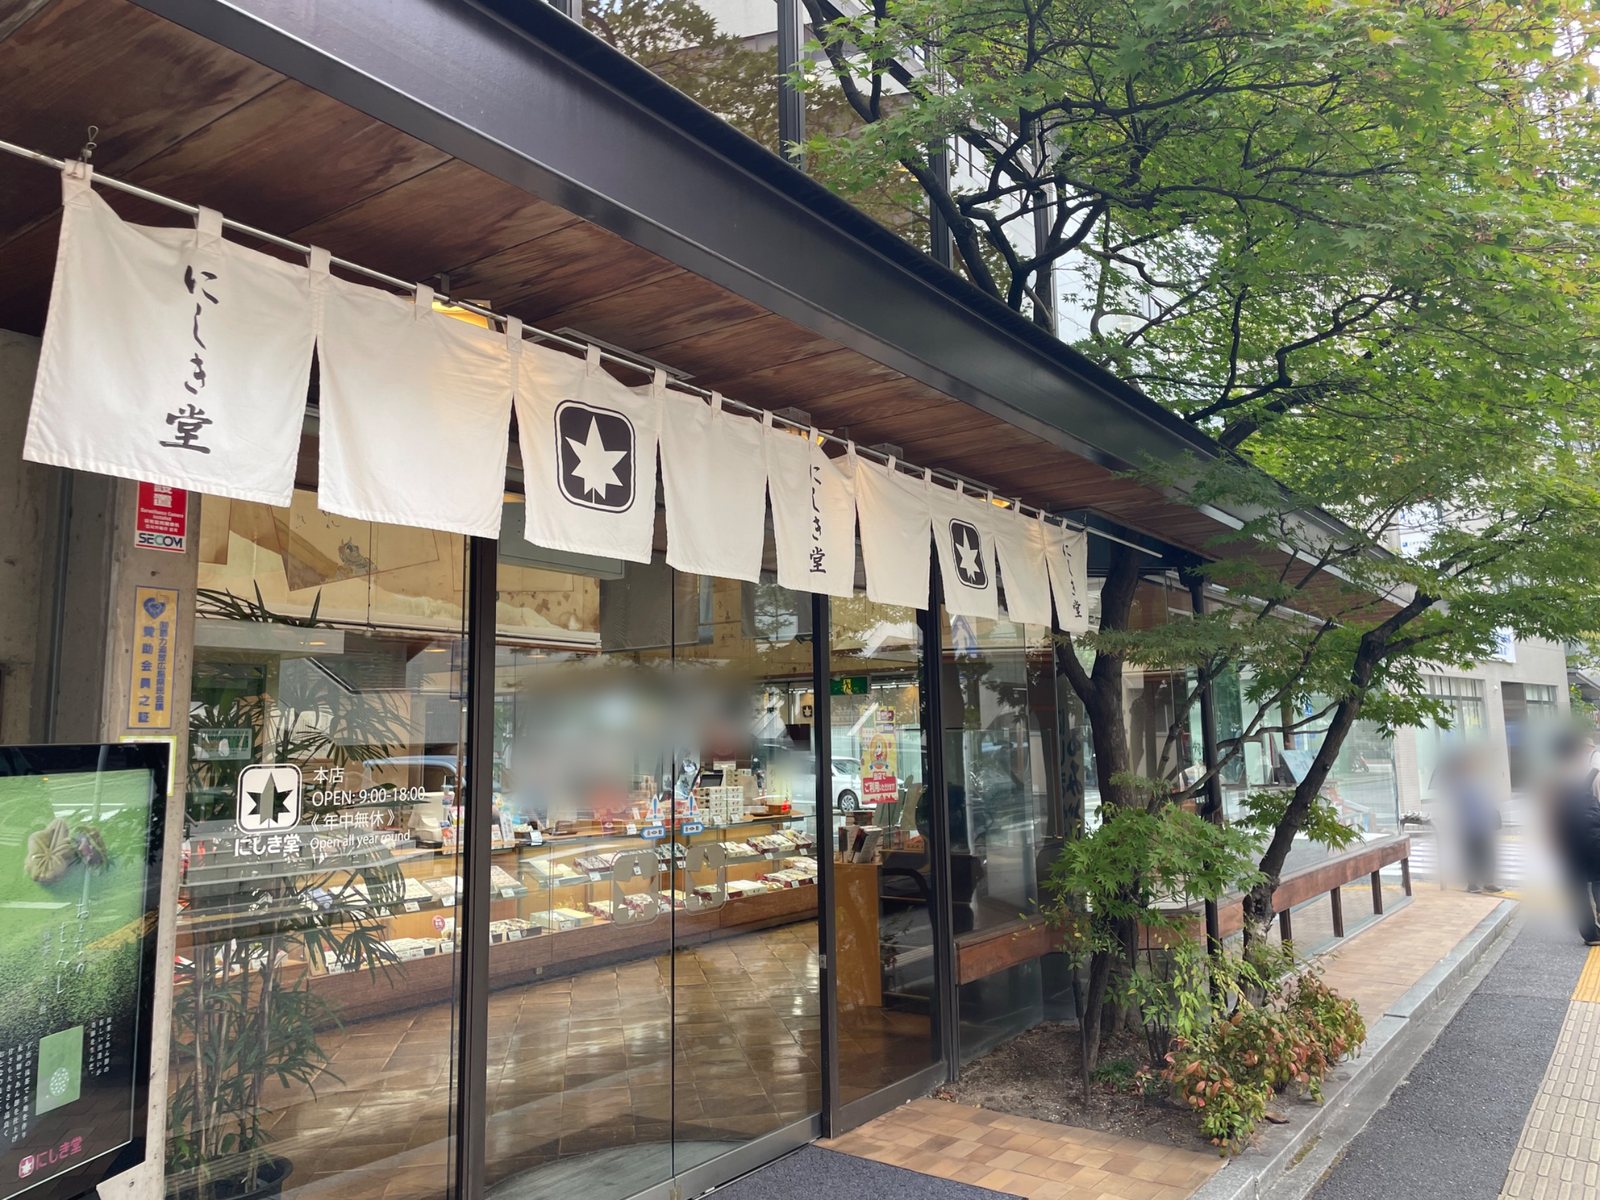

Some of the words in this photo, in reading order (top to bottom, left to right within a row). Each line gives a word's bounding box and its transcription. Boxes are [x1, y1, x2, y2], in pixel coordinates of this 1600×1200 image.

[160, 264, 220, 454] にしき堂
[808, 464, 827, 574] にしき堂
[138, 533, 183, 548] SECOM
[313, 766, 345, 784] 本店
[311, 791, 356, 807] OPEN:
[358, 786, 426, 804] 9:00-18:00
[234, 834, 302, 857] にしき堂
[310, 836, 341, 850] Open
[341, 834, 356, 847] all
[356, 834, 379, 848] year
[380, 830, 411, 843] round
[36, 1136, 83, 1170] にしき堂
